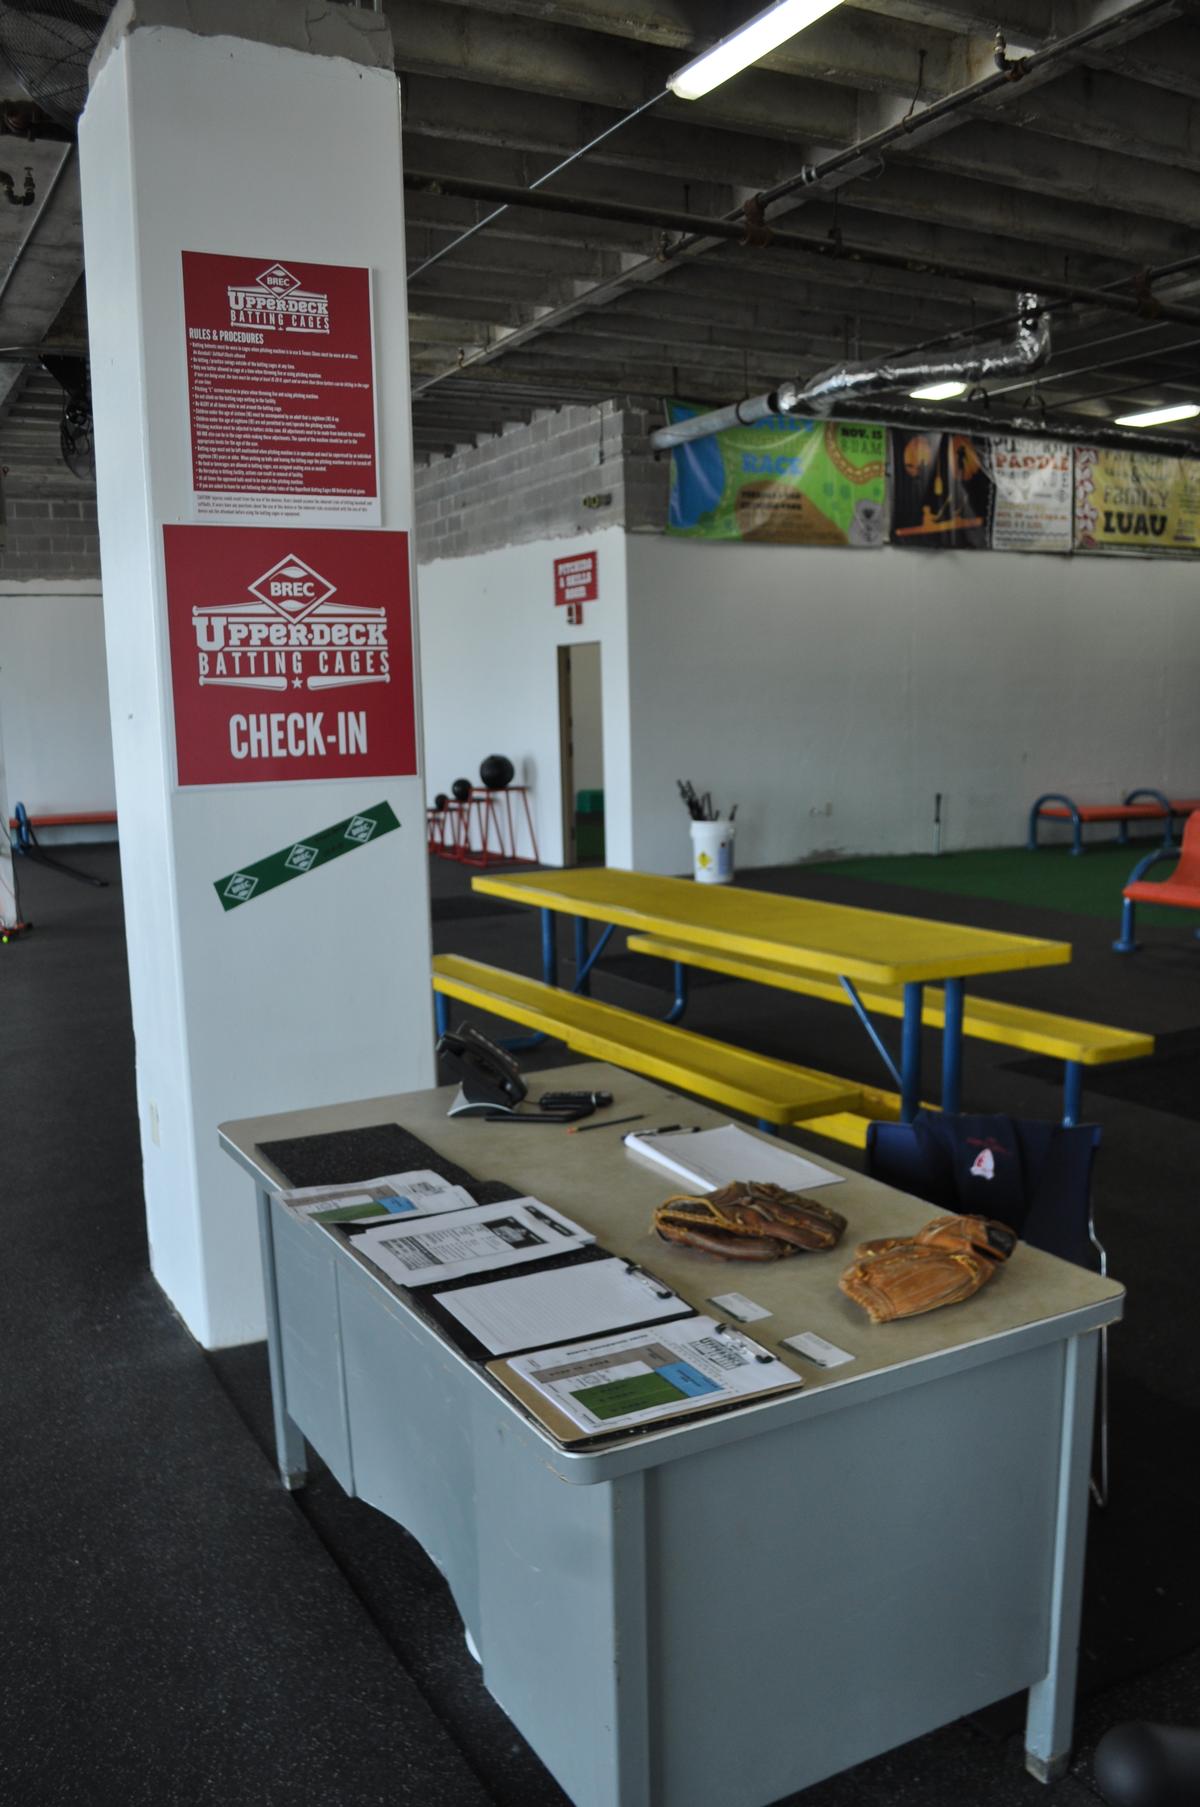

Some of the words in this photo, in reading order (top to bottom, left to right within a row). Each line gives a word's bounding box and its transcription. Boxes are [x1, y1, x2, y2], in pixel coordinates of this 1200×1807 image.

[266, 276, 290, 287] BREC
[231, 310, 284, 326] BATTING
[291, 315, 330, 329] CAGES
[188, 327, 211, 341] RULES
[212, 329, 219, 341] &
[220, 329, 264, 345] PROCEDURES
[1103, 511, 1168, 536] LUAU
[270, 582, 315, 597] BREC
[199, 651, 303, 675] BATTING
[318, 651, 390, 674] CAGES
[229, 711, 368, 759] CHECK-IN
